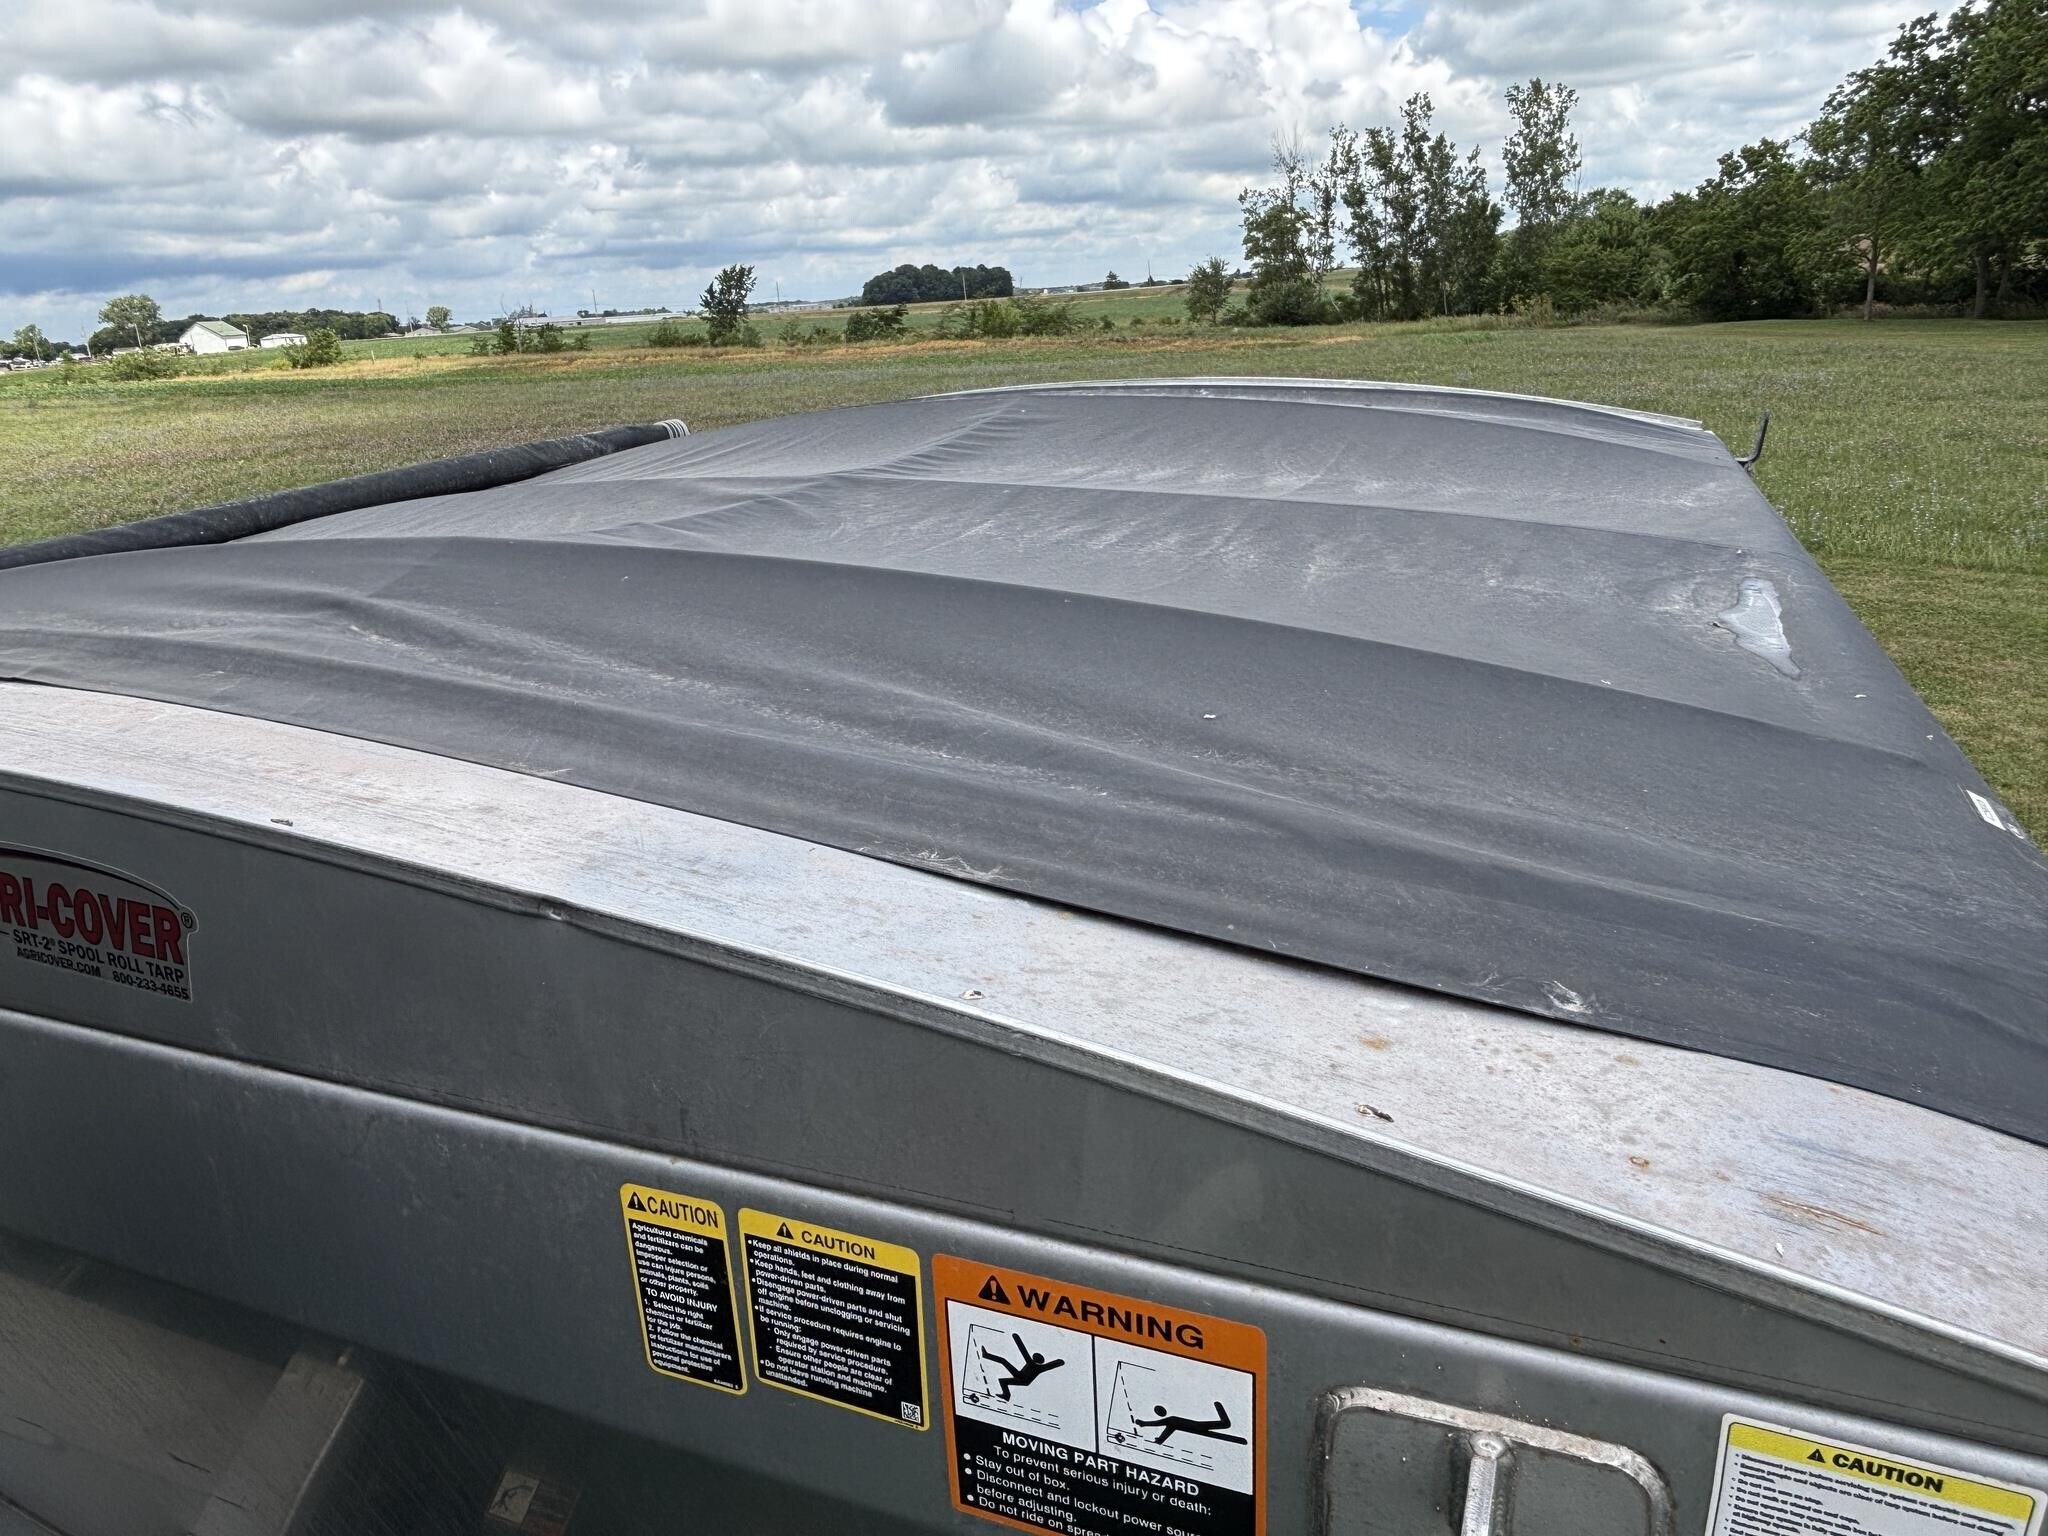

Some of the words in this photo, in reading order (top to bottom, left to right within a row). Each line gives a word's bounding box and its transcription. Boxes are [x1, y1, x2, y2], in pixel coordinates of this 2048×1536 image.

[57, 939, 105, 965] SPOOL
[106, 951, 145, 975] ROLL
[145, 961, 185, 984] TARP
[647, 1196, 719, 1228] CAUTION
[801, 1230, 876, 1260] CAUTION
[1018, 1286, 1204, 1349] WARNING
[975, 1454, 1002, 1473] Stay
[1005, 1465, 1025, 1478] out
[1027, 1471, 1040, 1483] of
[1043, 1473, 1070, 1491] box.
[992, 1445, 1010, 1459] To
[1013, 1453, 1059, 1473] prevent
[1062, 1467, 1109, 1487] serious
[1112, 1479, 1149, 1500] injury
[1151, 1492, 1166, 1503] or
[1169, 1497, 1212, 1516] death:
[1002, 1431, 1068, 1460] MOVING
[1073, 1451, 1119, 1474] PART
[1125, 1466, 1199, 1496] HAZARD
[1832, 1453, 1944, 1493] CAUTION
[976, 1469, 1043, 1498] Disconnect
[1046, 1491, 1071, 1506] and
[1073, 1497, 1119, 1520] lockout
[1122, 1513, 1162, 1532] power
[1166, 1526, 1203, 1536] sour
[976, 1483, 1015, 1503] before
[1018, 1497, 1077, 1523] adjusting.
[978, 1495, 996, 1510] Do
[998, 1503, 1018, 1517] not
[1020, 1509, 1044, 1524] ride
[1047, 1518, 1064, 1531] on
